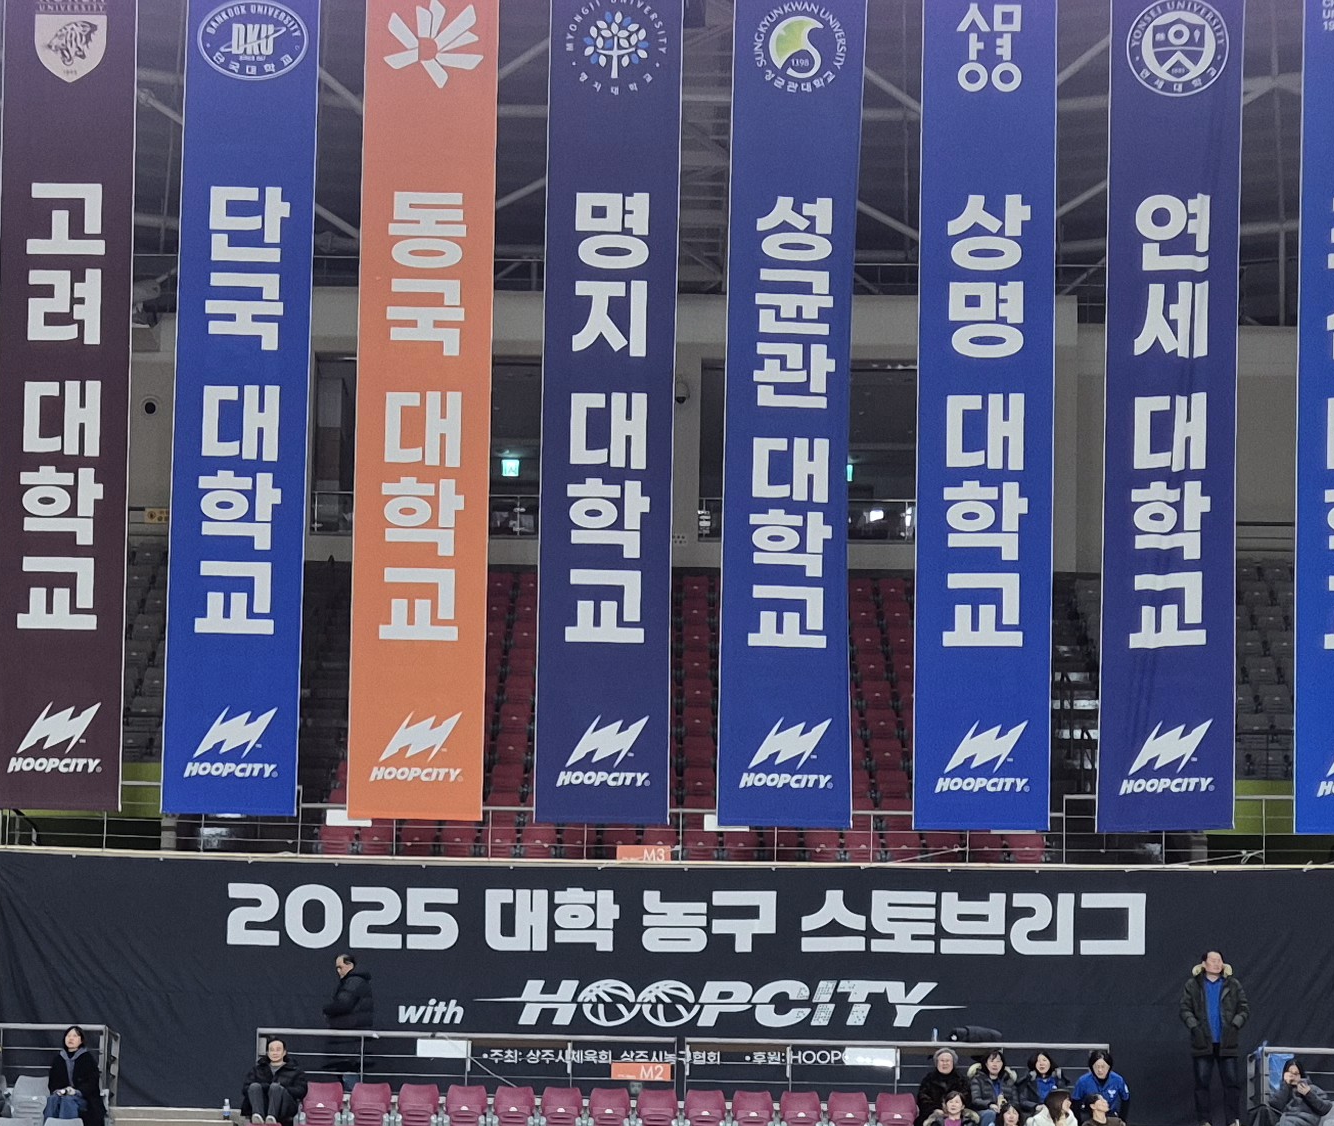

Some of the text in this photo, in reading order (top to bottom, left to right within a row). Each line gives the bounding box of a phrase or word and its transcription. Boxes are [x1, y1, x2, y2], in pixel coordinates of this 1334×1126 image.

[231, 23, 275, 56] DKU
[250, 4, 301, 37] UNIVERSITY
[819, 7, 847, 70] UNIVERSITY
[1130, 1, 1225, 48] YONSEI UNIVERSITY
[17, 182, 106, 631] 고려 대학교
[194, 185, 290, 635] 단국 대학교
[378, 191, 467, 641] 동국 대학교
[565, 191, 651, 644] 명지 대학교
[747, 195, 836, 649] 성균관 대학교
[942, 193, 1031, 648] 상명 대학교
[1128, 193, 1211, 650] 연세 대학교
[7, 756, 99, 774] HOOPCITY
[183, 761, 275, 779] HOOPCITY
[369, 765, 460, 783] HOOPCITY
[556, 770, 647, 789] HOOPCITY
[739, 772, 830, 790] HOOPCITY
[934, 775, 1027, 795] HOOPCITY
[1118, 778, 1212, 796] HOOPCITY
[642, 847, 665, 861] M3
[227, 883, 1146, 956] 2025 대학 농구 스토브리그
[397, 979, 940, 1028] with HOOPCITY
[639, 1065, 664, 1080] M2
